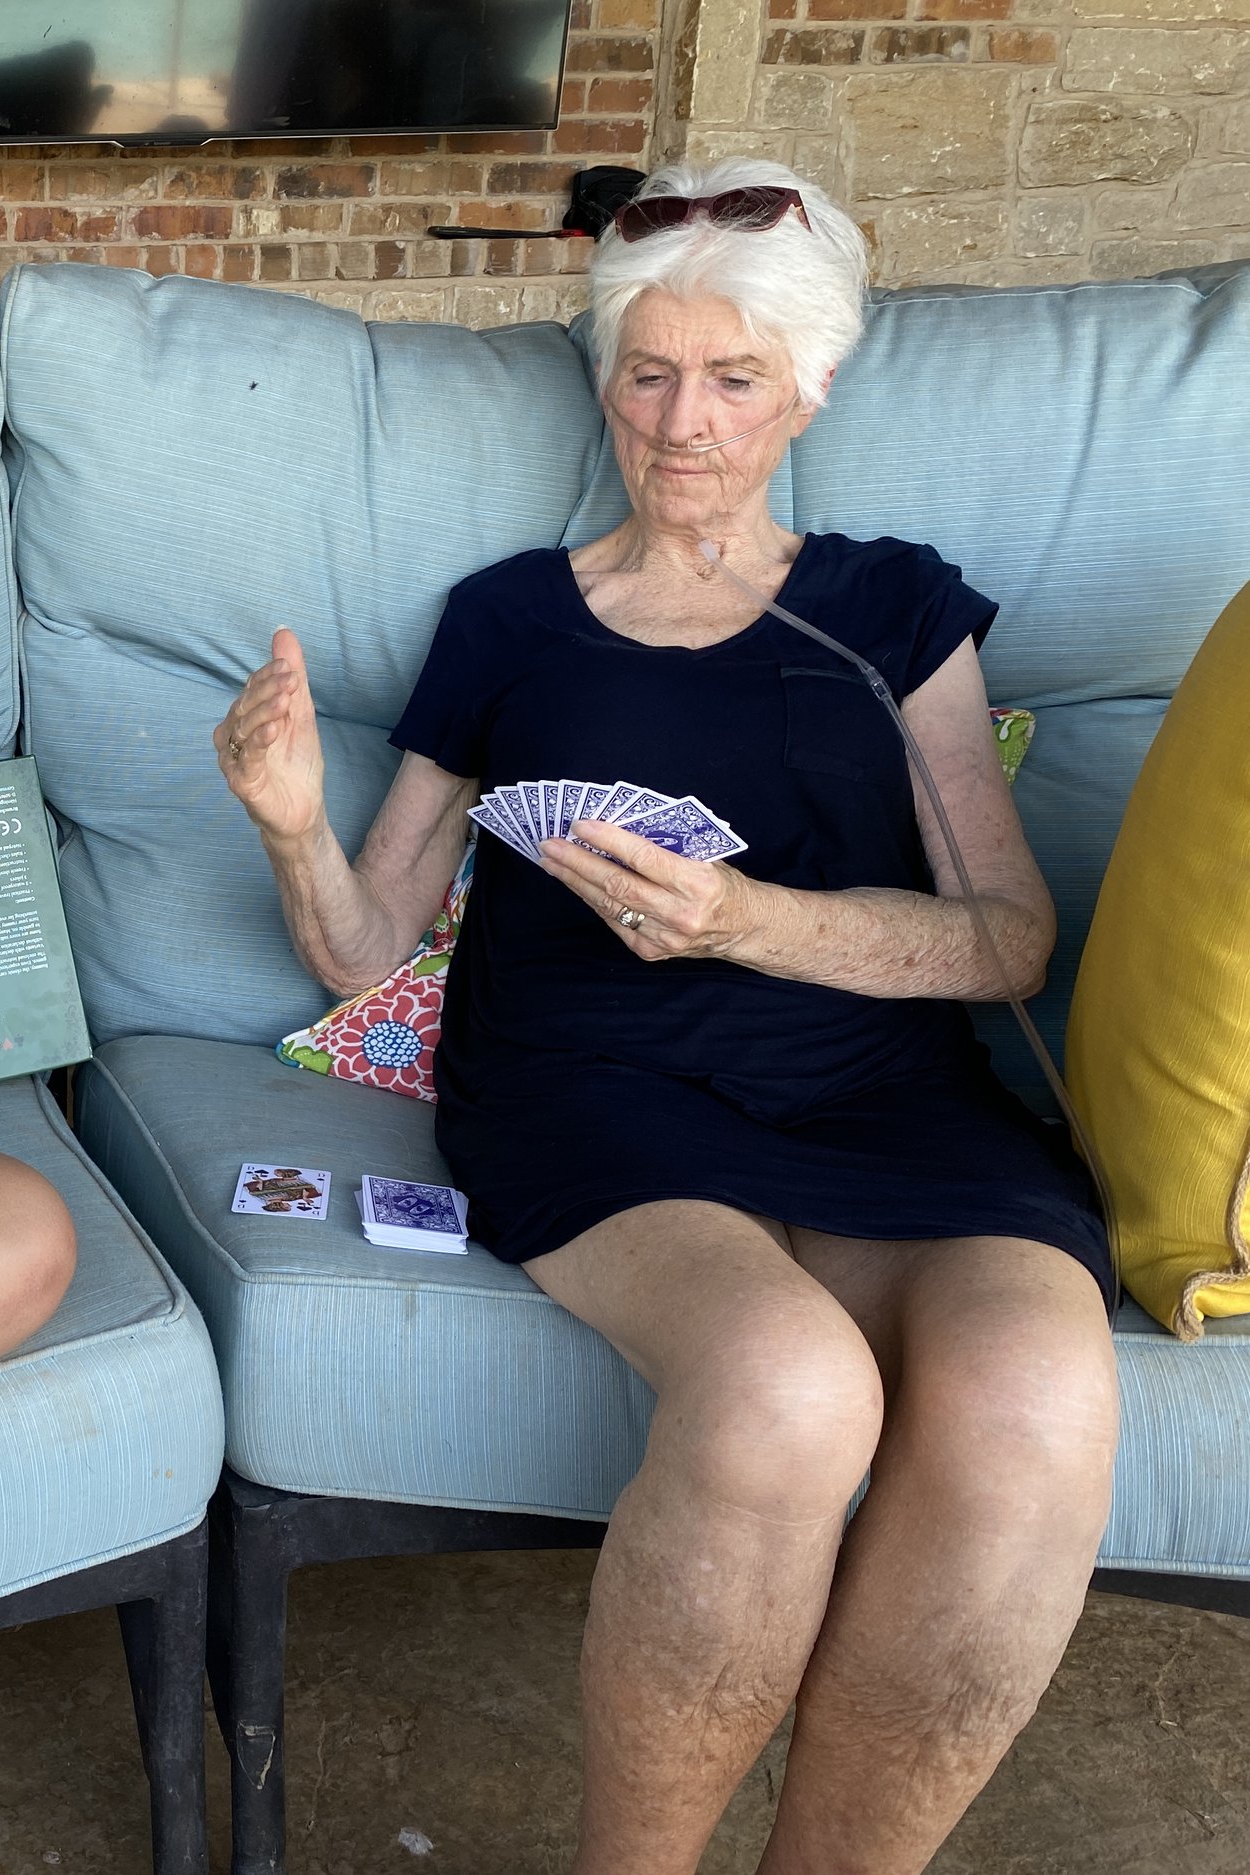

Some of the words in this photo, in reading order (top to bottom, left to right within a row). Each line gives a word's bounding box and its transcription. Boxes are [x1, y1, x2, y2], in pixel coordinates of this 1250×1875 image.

[10, 888, 30, 897] Practical
[0, 940, 25, 949] declaration
[17, 952, 36, 961] enclosed
